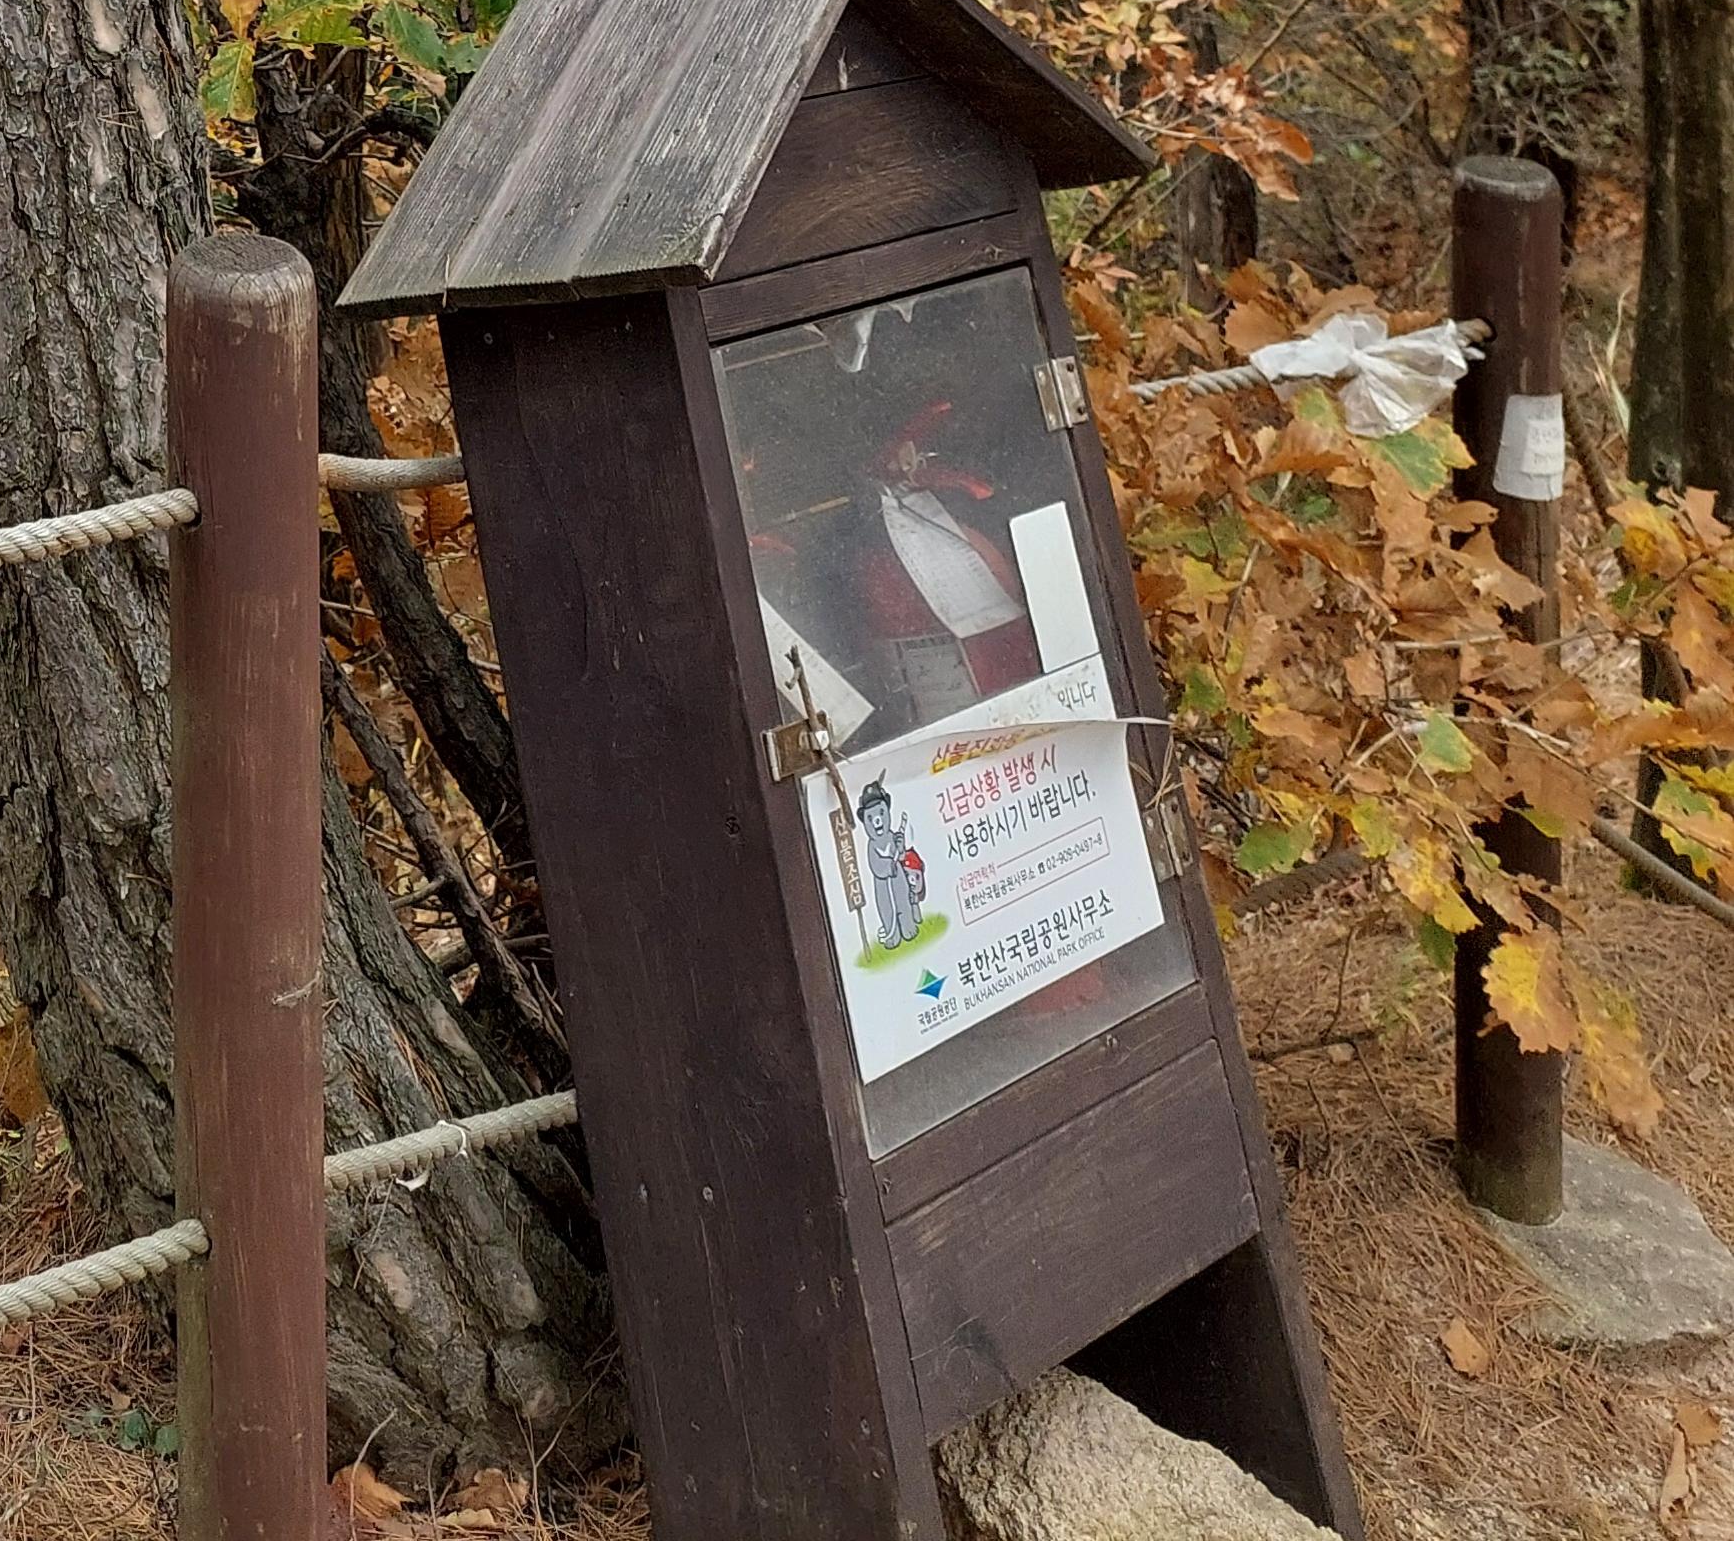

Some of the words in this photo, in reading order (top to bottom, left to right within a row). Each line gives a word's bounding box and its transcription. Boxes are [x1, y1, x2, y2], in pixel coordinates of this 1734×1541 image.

[936, 766, 1002, 824] 긴급상황
[1002, 751, 1038, 794] 발생
[1041, 743, 1058, 774] 시
[947, 798, 1028, 862] 사용하시기
[1027, 769, 1097, 823] 바랍니다.
[958, 888, 1114, 989] 북한산국립공원사무소
[964, 973, 1016, 1011] BUKHANSAN
[1016, 955, 1058, 983] NATIONAL
[1057, 943, 1078, 965] PARK
[1078, 926, 1106, 950] OFFICE
